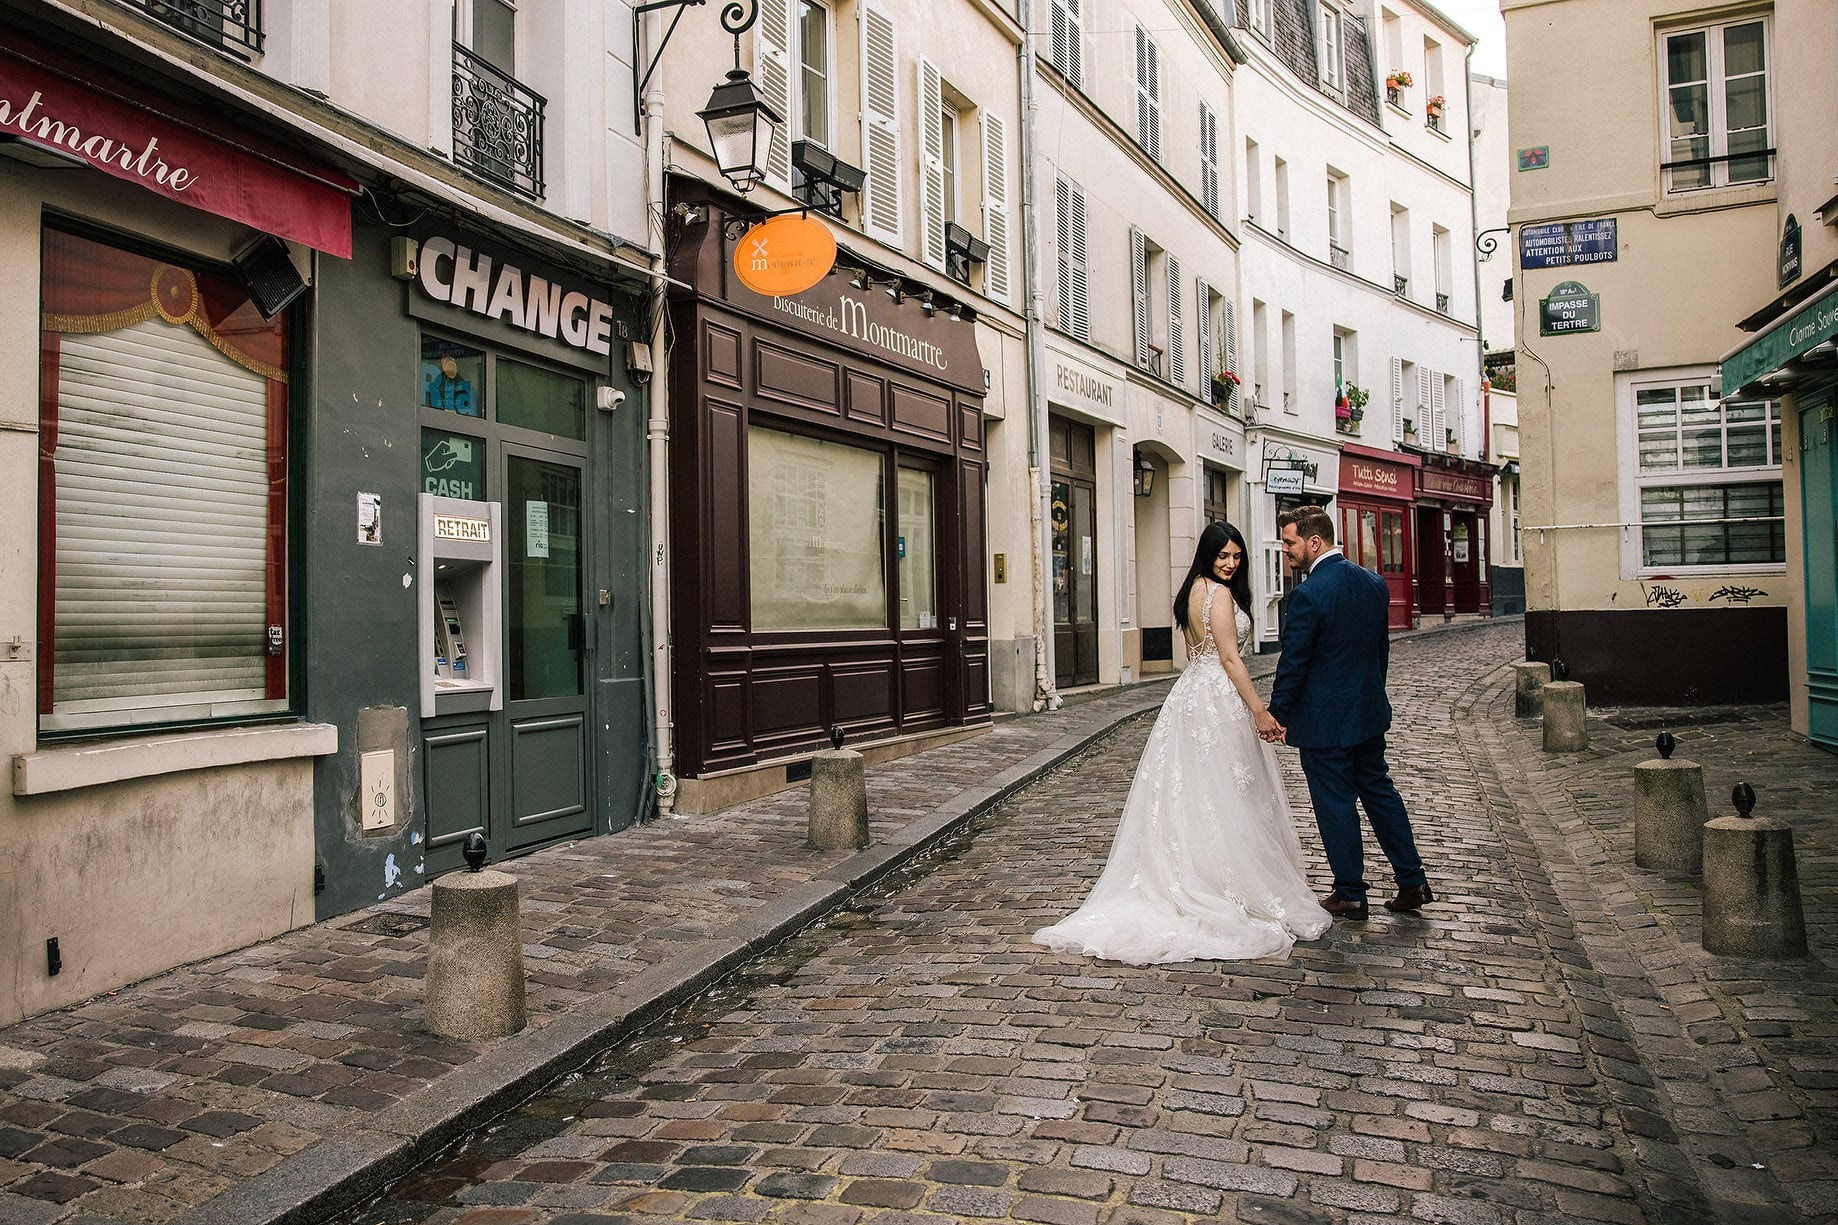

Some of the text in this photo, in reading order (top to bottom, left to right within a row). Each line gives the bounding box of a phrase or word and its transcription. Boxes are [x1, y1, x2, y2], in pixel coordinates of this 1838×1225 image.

[1525, 232, 1612, 248] AUTOMOBILISTES RALENTISSEZ
[1526, 244, 1583, 257] ATTENTION AUX
[1546, 251, 1613, 265] PETITS POULBOTS
[419, 236, 614, 356] CHANGE
[1549, 299, 1589, 311] IMPASSE
[1551, 319, 1588, 330] TERTRE
[1562, 310, 1576, 319] DU
[617, 320, 628, 339] 18
[826, 306, 838, 330] de
[840, 294, 948, 370] Montmartre
[1789, 319, 1815, 347] Charme
[1057, 364, 1113, 407] RESTAURANT
[1211, 432, 1234, 456] GALERIE
[1352, 464, 1398, 485] Tutti Sensi
[425, 476, 473, 500] CASH
[437, 518, 488, 540] RETRAIT
